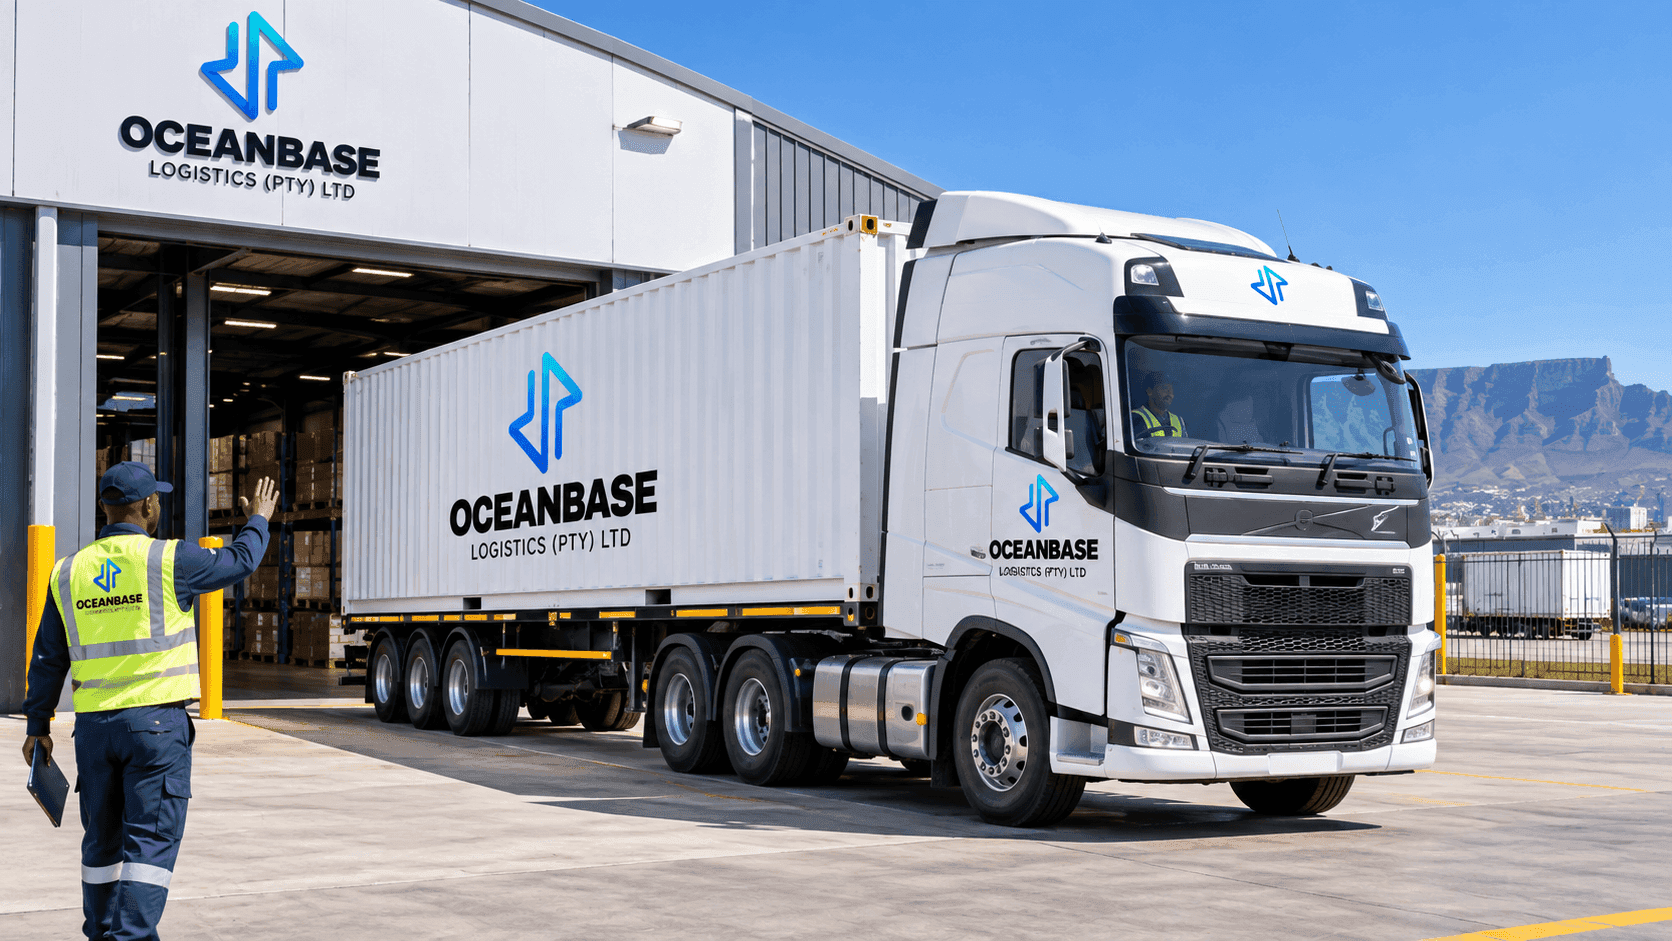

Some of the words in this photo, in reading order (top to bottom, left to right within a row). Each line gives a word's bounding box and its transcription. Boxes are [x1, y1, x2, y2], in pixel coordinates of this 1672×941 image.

[120, 115, 380, 178] OCEANBASE
[150, 160, 257, 187] LOGISTICS
[265, 173, 315, 197] (PTY)
[322, 181, 355, 199] LTD
[450, 469, 657, 536] OCEANBASE
[471, 536, 546, 560] LOGISTICS
[552, 530, 594, 555] (PTY)
[601, 527, 631, 548] LTD
[989, 539, 1099, 560] OCEANBASE
[1069, 567, 1086, 578] LTD
[76, 593, 143, 610] OCEANBASE
